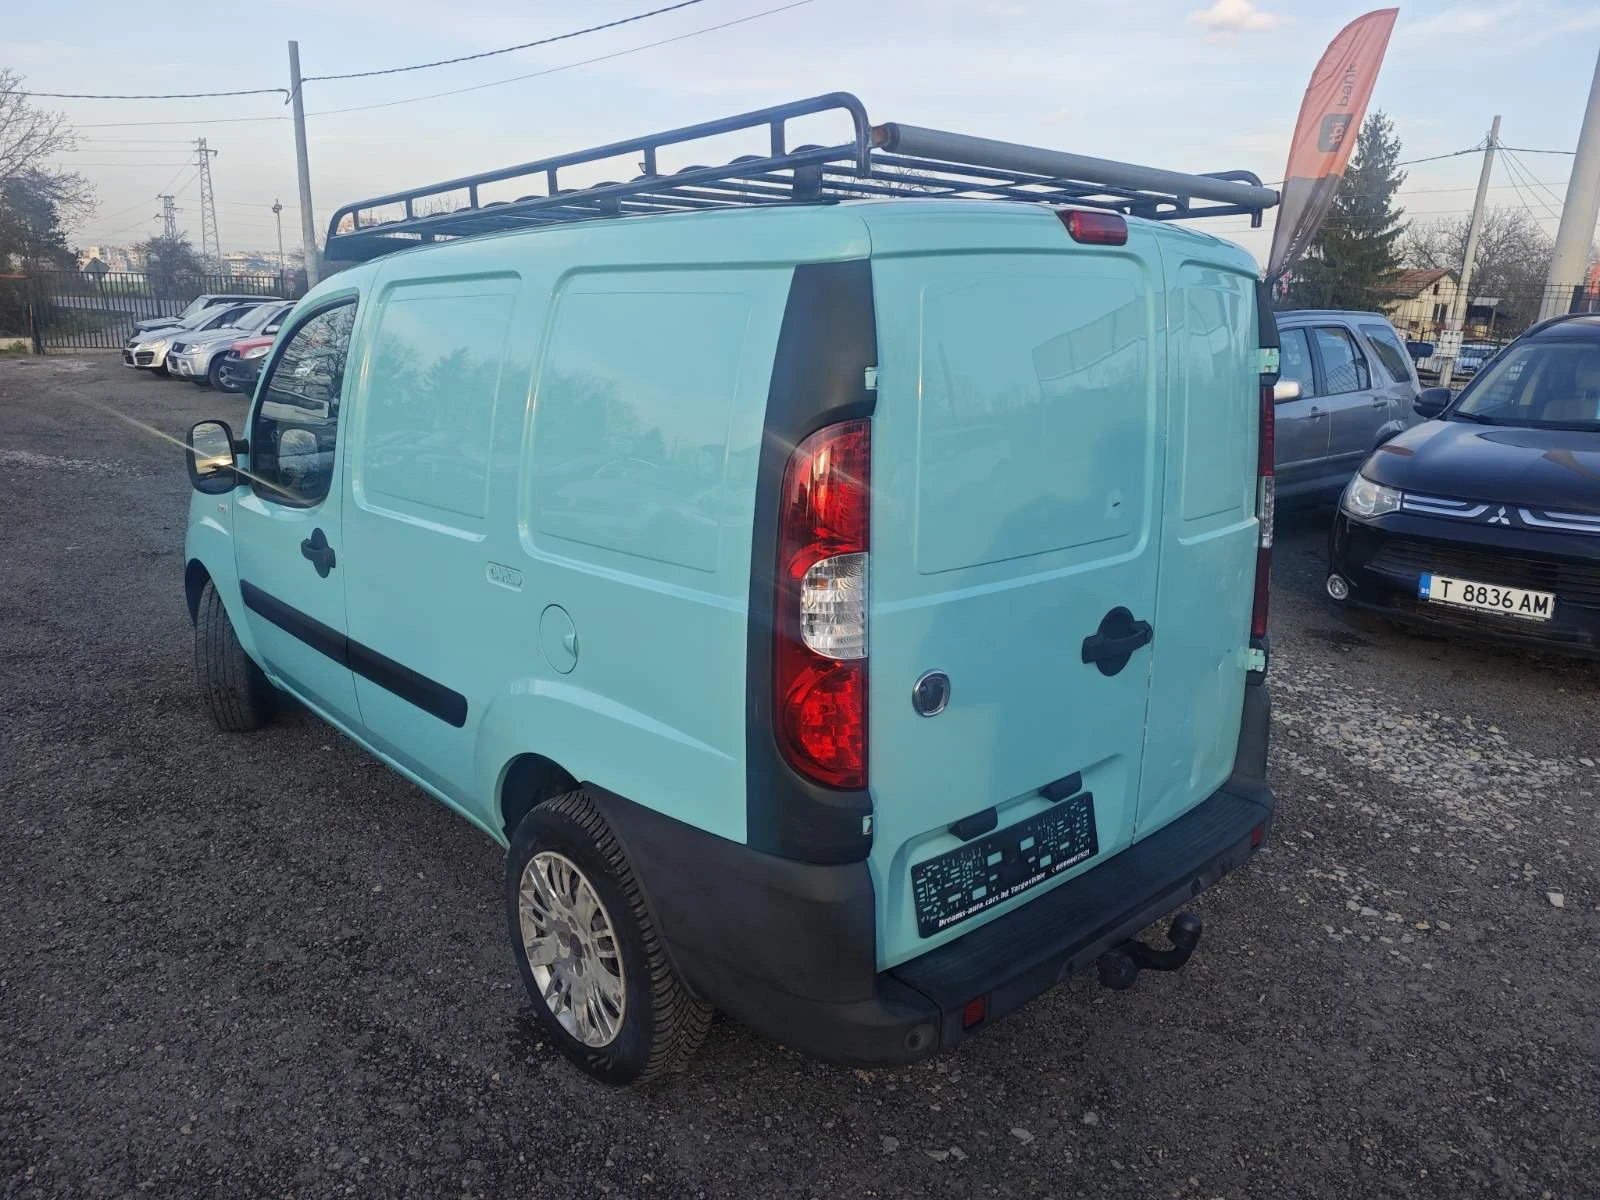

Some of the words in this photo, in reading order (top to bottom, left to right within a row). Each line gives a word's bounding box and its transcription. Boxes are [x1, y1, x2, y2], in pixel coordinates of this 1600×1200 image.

[1336, 64, 1356, 106] bank
[1329, 122, 1345, 144] tbi
[1441, 580, 1452, 598] T
[1463, 584, 1513, 609] 8836
[1519, 593, 1548, 614] AM
